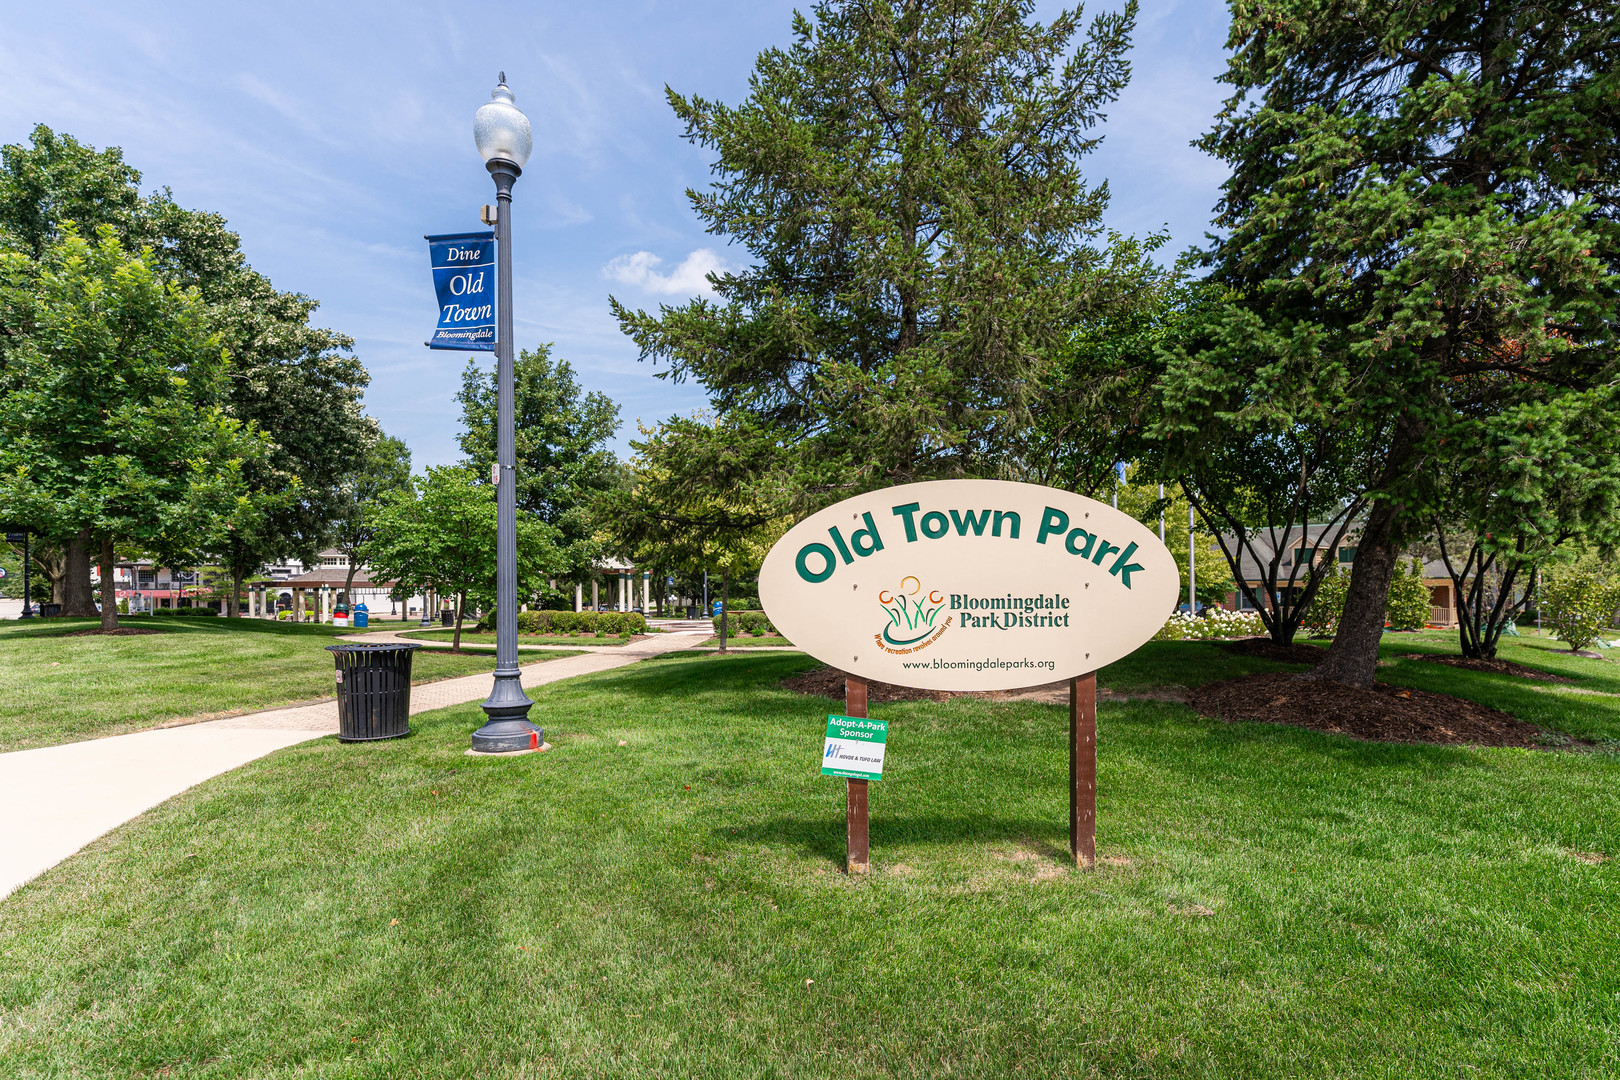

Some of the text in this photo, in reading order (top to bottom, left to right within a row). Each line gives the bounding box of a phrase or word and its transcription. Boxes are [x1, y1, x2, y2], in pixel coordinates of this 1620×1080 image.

[447, 246, 481, 262] Dine
[449, 272, 485, 296] Old
[442, 304, 492, 323] Town
[436, 329, 493, 340] Bloomingdale
[795, 501, 1145, 590] Old Town Park
[949, 593, 1070, 613] Bloomingdale
[960, 611, 1070, 630] Park District
[885, 647, 912, 655] recreation
[912, 639, 933, 653] revolves
[931, 623, 948, 642] around
[944, 615, 953, 627] you
[902, 657, 1055, 672] www.bloomingdaleparks.org
[829, 718, 886, 731] Adopt-A-Park
[839, 728, 874, 739] Sponsor
